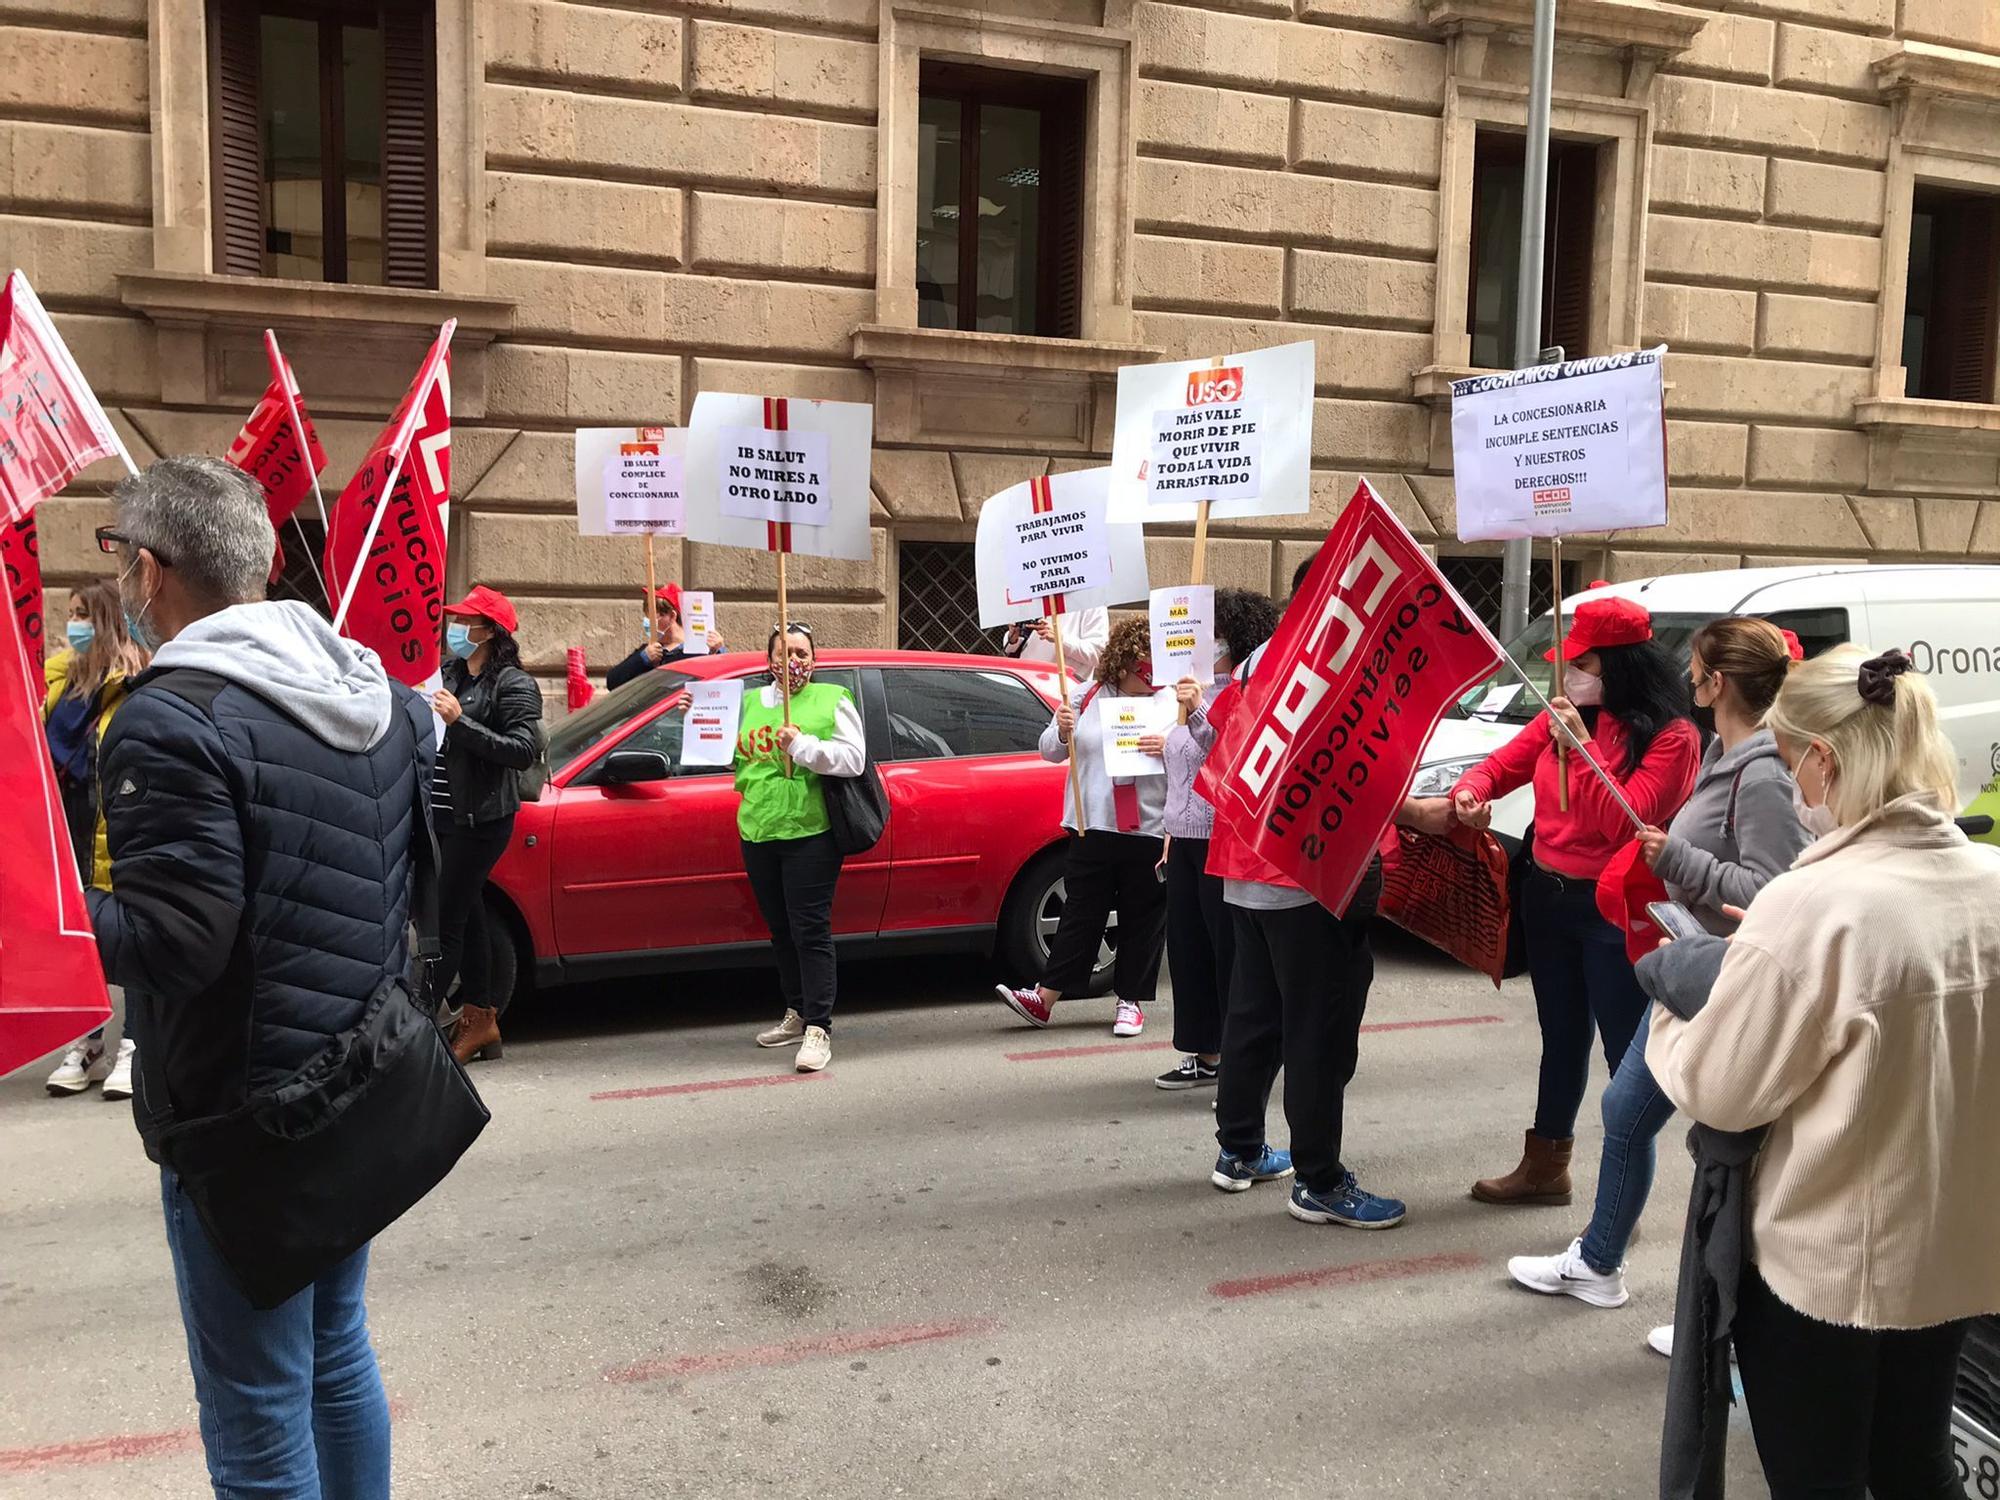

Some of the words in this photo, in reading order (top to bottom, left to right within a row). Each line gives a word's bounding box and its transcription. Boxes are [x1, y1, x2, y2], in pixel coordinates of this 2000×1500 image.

[1563, 352, 1634, 377] UNIDOS
[1188, 378, 1238, 405] USO
[1176, 408, 1203, 426] MÁS
[1205, 408, 1242, 421] VALE
[1493, 413, 1509, 426] LA
[1512, 399, 1607, 424] CONCESIONARIA
[1159, 427, 1205, 443] MORIR
[1207, 425, 1228, 437] DE
[1231, 423, 1256, 436] PIE
[1485, 431, 1539, 449] INCUMPLE
[1542, 420, 1619, 442] SENTENCIAS
[738, 446, 754, 459] IB
[758, 448, 806, 464] SALUT
[1172, 445, 1198, 460] QUE
[1200, 441, 1240, 454] VIVIR
[1514, 455, 1524, 468] Y
[1525, 448, 1586, 466] NUESTROS
[624, 460, 635, 468] IB
[1157, 460, 1195, 474] TODA
[1197, 458, 1213, 470] LA
[1217, 456, 1252, 469] VIDA
[729, 465, 751, 479] NO
[754, 467, 806, 484] MIRES
[808, 473, 820, 485] A
[1156, 472, 1250, 490] ARRASTRADO
[1514, 472, 1588, 490] DERECHOS!!!
[728, 485, 771, 500] OTRO
[773, 490, 818, 505] LADO
[1534, 489, 1569, 502] CCOO
[1015, 510, 1087, 532] TRABAJAMOS
[1020, 530, 1048, 544] PARA
[1051, 524, 1084, 537] VIVIR
[1022, 560, 1037, 571] NO
[1040, 550, 1089, 567] VIVIMOS
[1040, 566, 1071, 579] PARA
[1030, 575, 1086, 593] TRABAJAR
[1165, 638, 1196, 648] MENOS
[1980, 783, 1999, 794] NON
